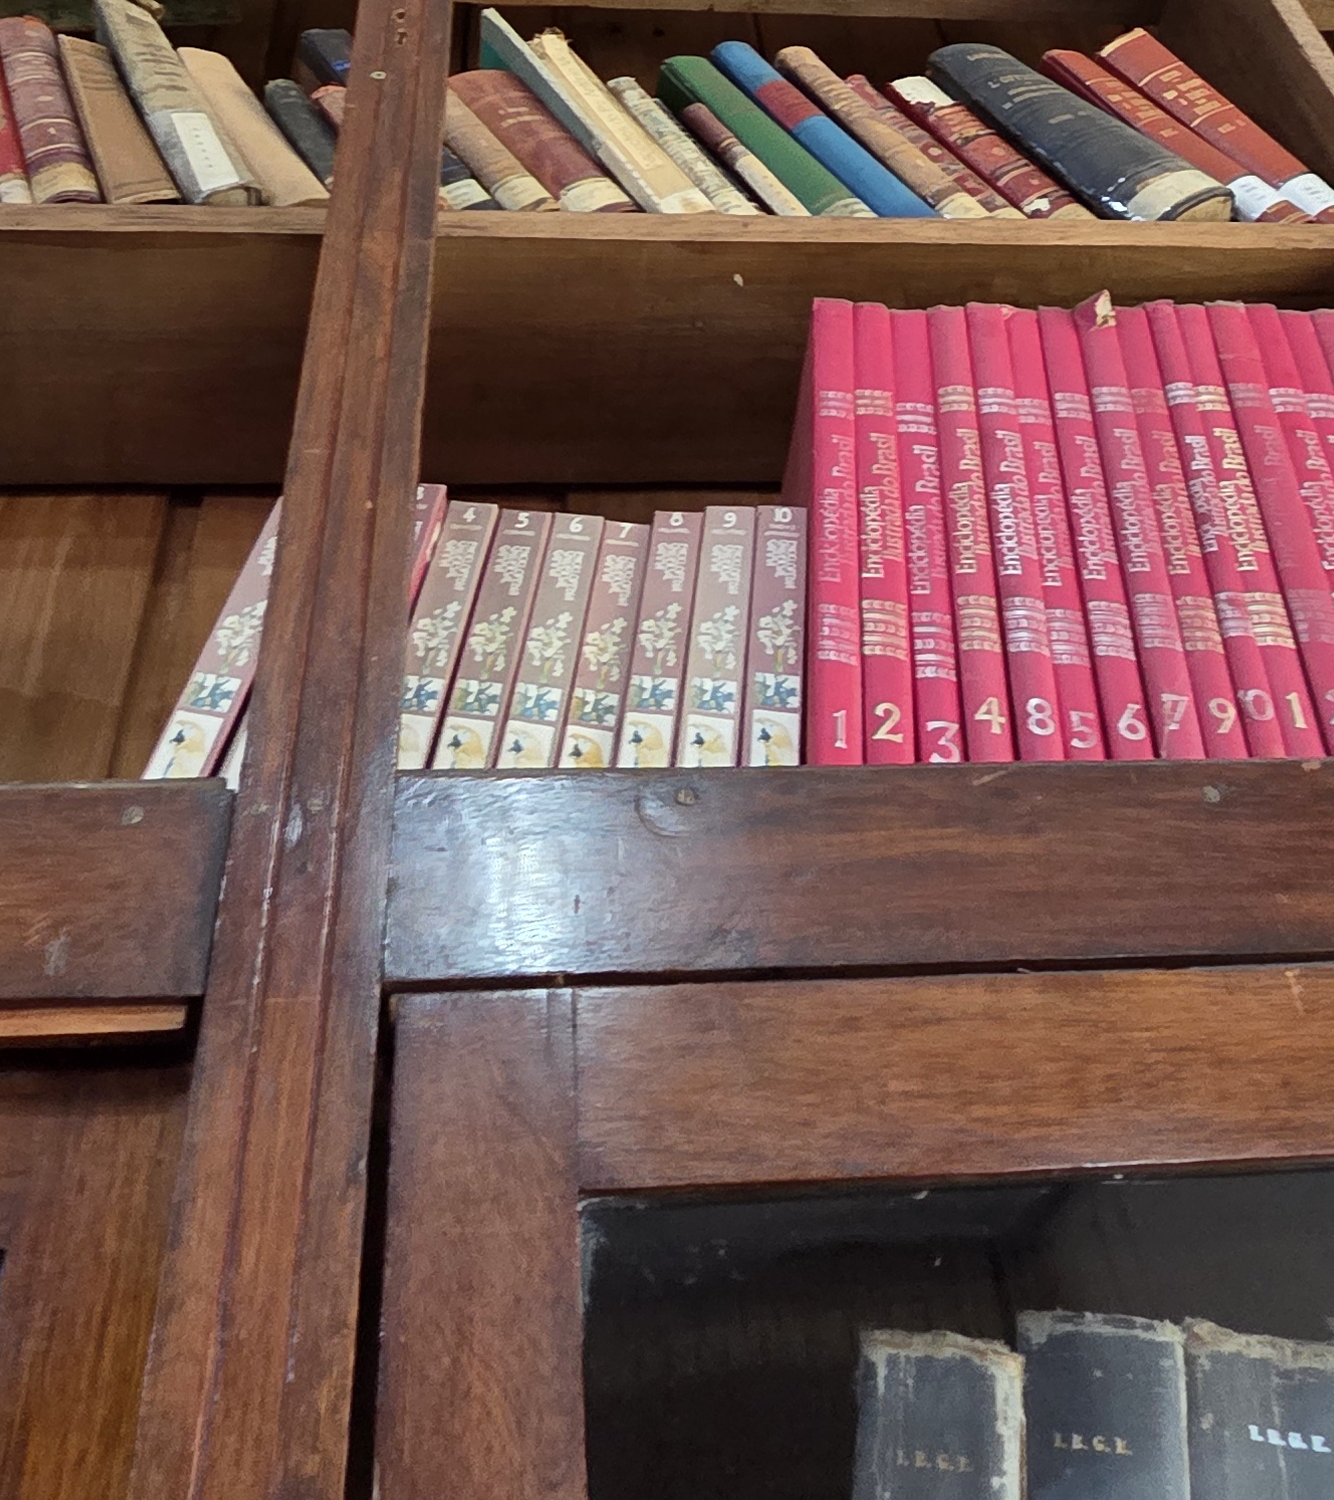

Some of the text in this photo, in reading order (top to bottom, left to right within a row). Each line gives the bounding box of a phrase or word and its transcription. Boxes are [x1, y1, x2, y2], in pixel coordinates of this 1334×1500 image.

[463, 507, 476, 522] 4
[514, 512, 530, 528] 5
[569, 517, 583, 533] 6
[619, 522, 634, 538] 7
[723, 512, 737, 527] 9
[774, 507, 793, 523] 10
[832, 709, 848, 749] 1
[872, 702, 904, 743] 2
[974, 697, 1006, 734] 4
[1026, 697, 1056, 736] 8
[1070, 711, 1097, 749] 5
[1119, 703, 1147, 740] 6
[1208, 698, 1237, 734] 9
[926, 721, 961, 763] 3
